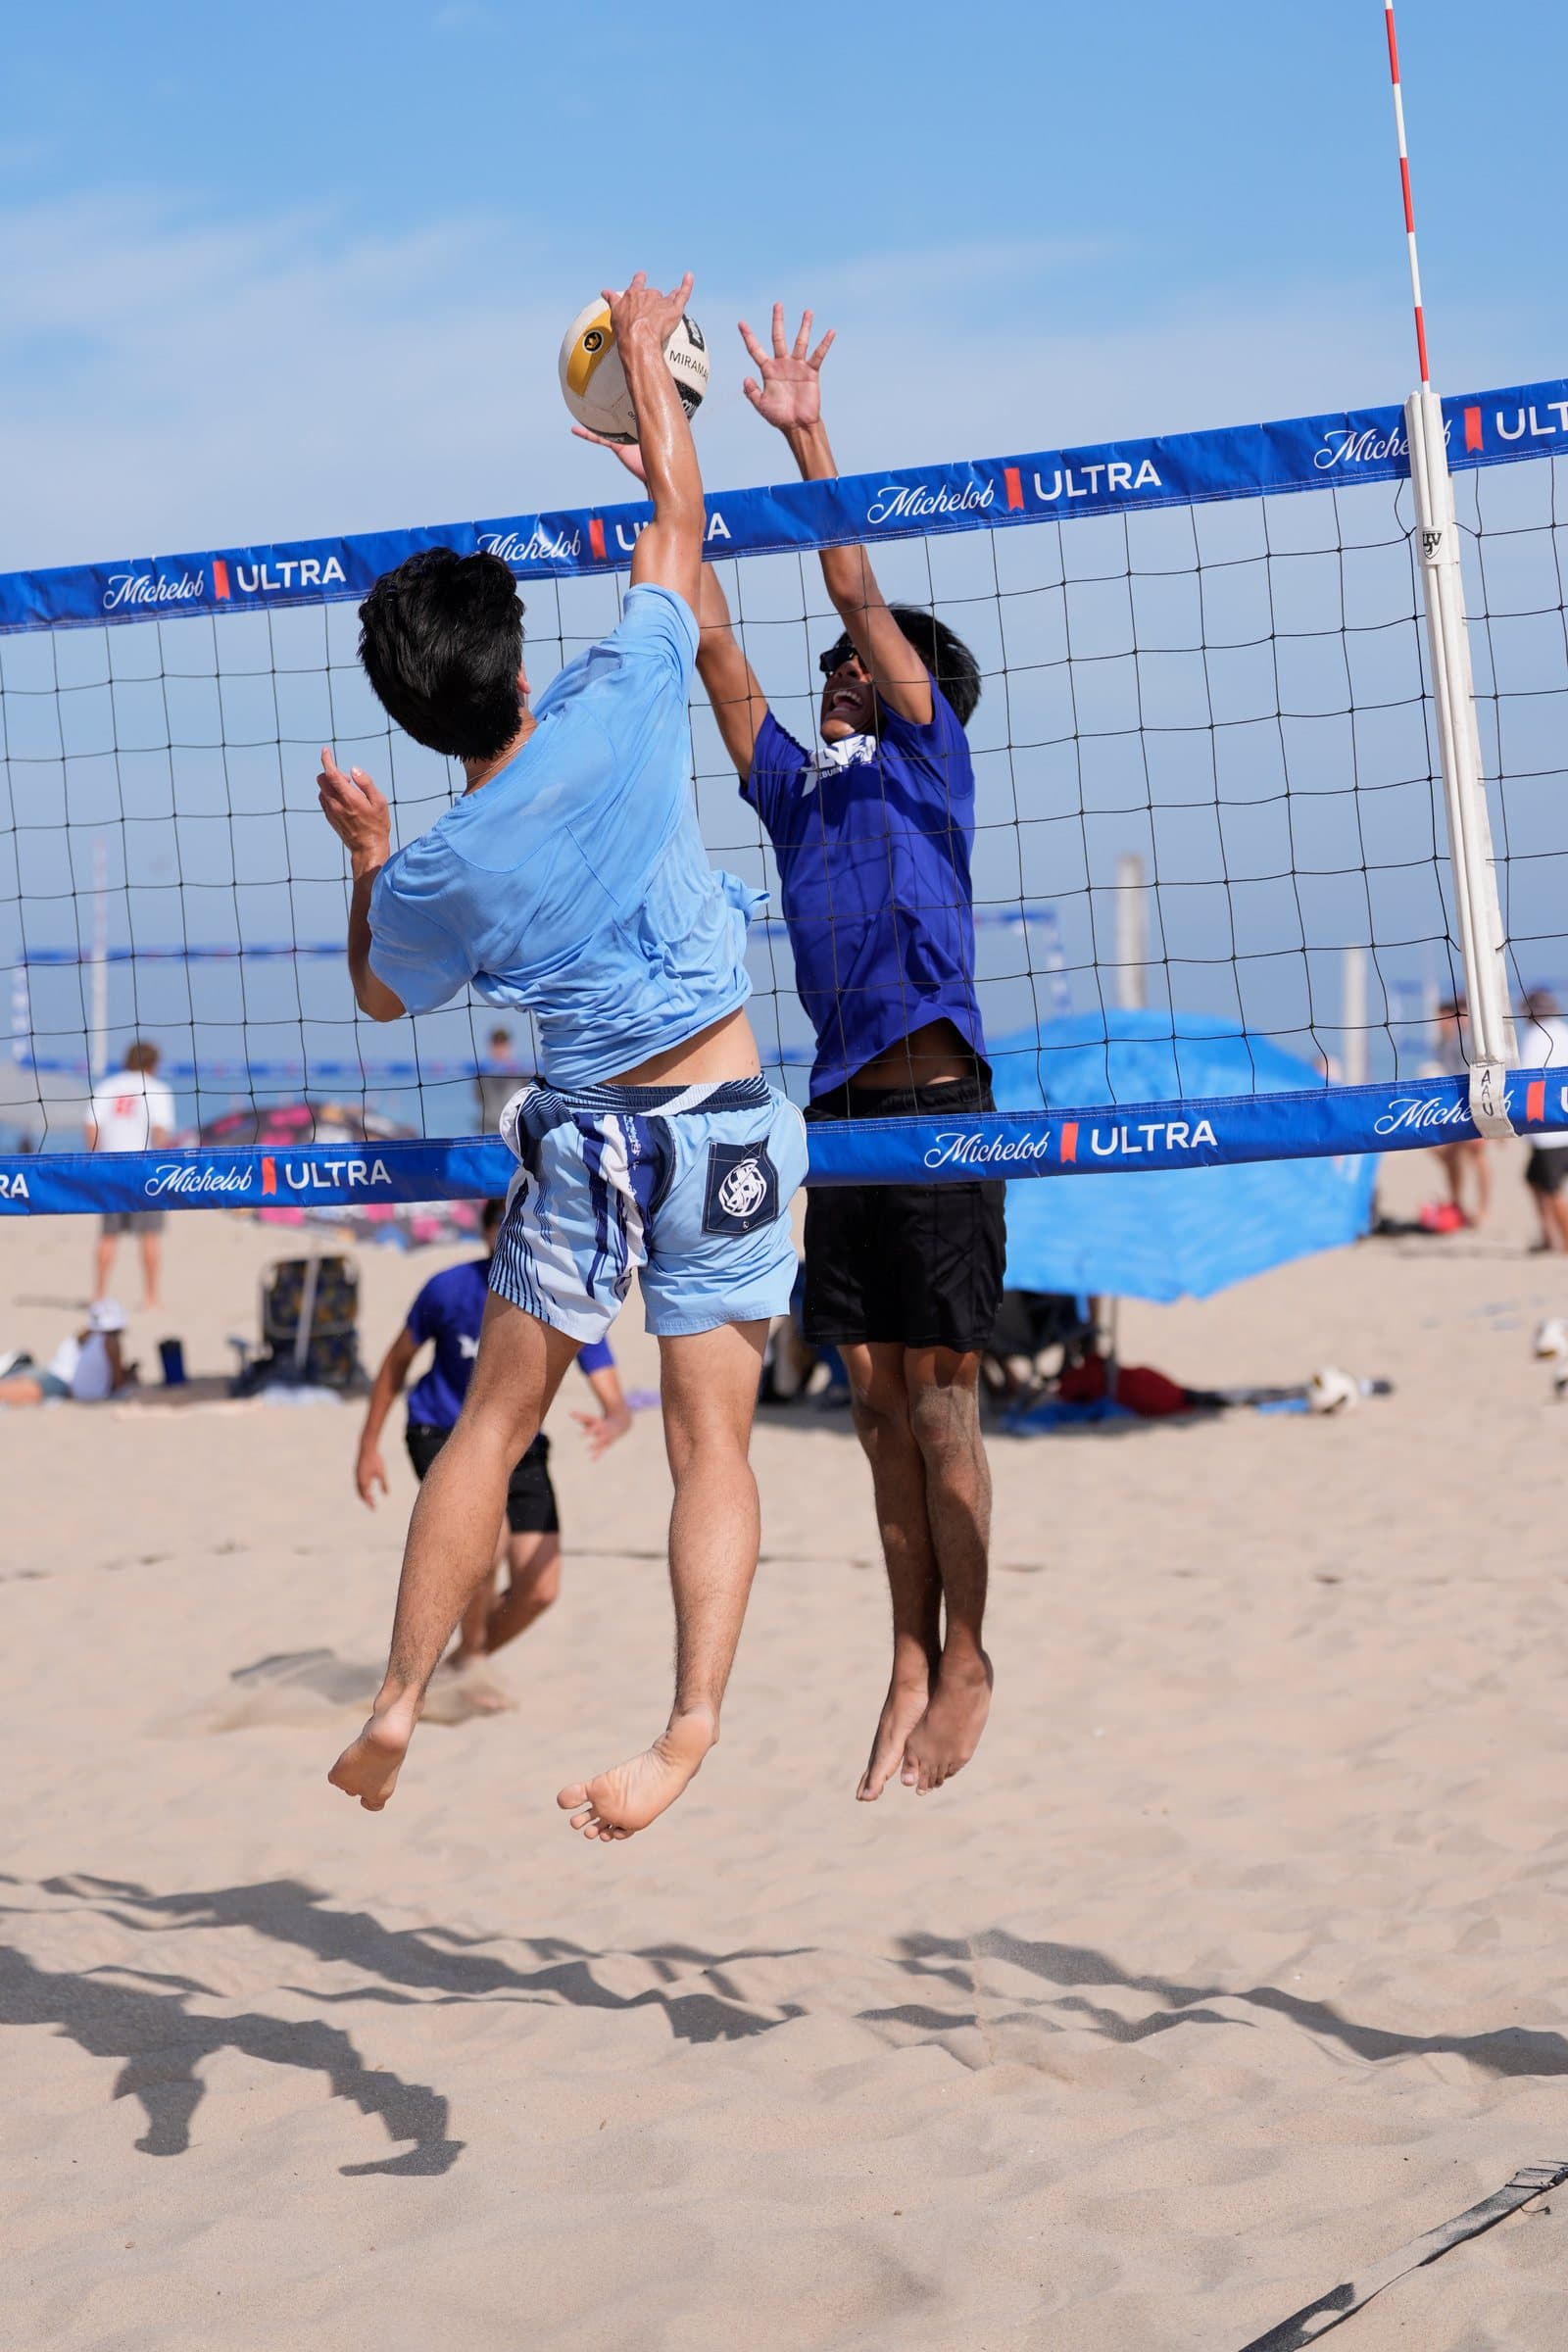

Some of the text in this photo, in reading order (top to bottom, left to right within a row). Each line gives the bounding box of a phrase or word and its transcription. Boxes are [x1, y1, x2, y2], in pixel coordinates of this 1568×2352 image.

[1313, 401, 1568, 469] Micheb ULT
[867, 460, 1161, 524] Michelob ULTRA
[476, 529, 581, 563] Michelob
[103, 557, 346, 610] Michelob ULTRA
[1374, 1089, 1515, 1135] Micheb
[924, 1120, 1218, 1168] Michelob ULTRA
[144, 1159, 393, 1197] Michelob ULTRA
